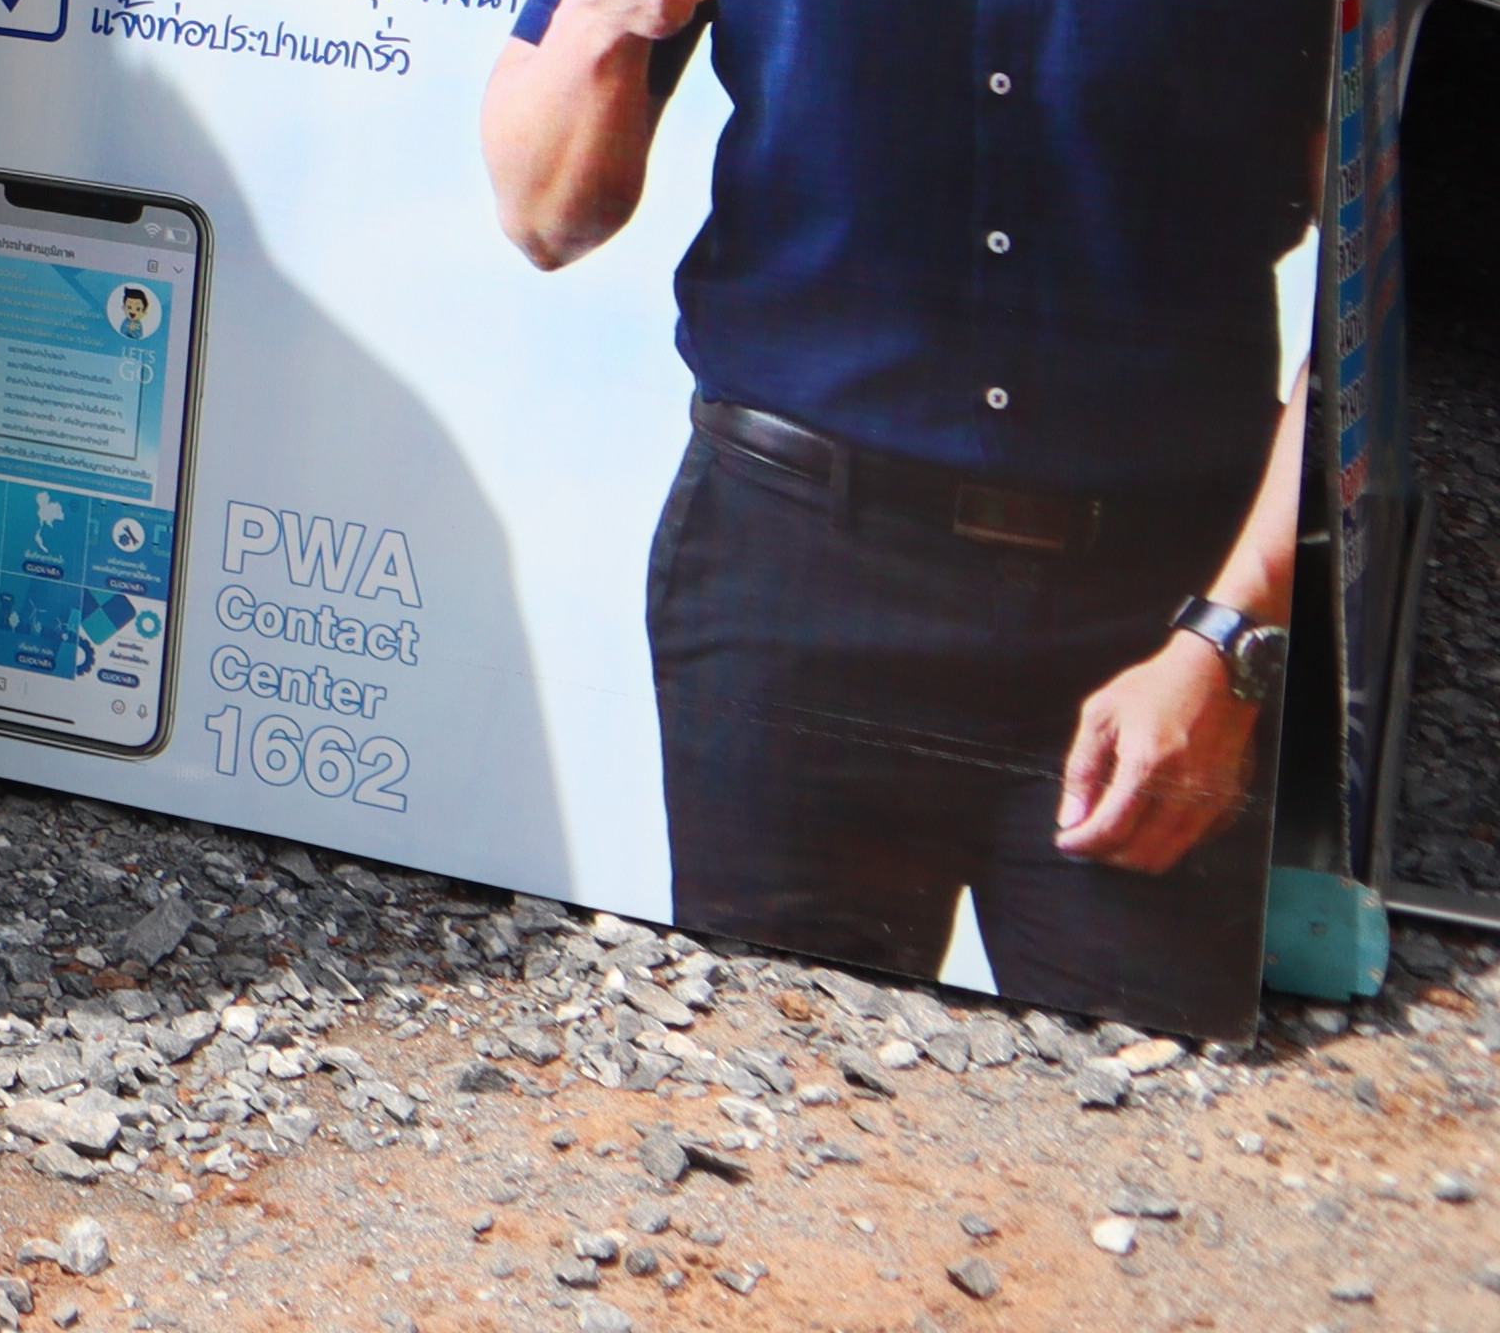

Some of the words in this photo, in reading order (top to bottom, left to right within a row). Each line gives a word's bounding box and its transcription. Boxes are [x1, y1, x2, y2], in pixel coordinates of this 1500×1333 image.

[119, 360, 155, 385] GO
[220, 500, 423, 609] PWA
[214, 584, 421, 667] Contact
[208, 643, 388, 720] Center
[204, 704, 410, 813] 1662
